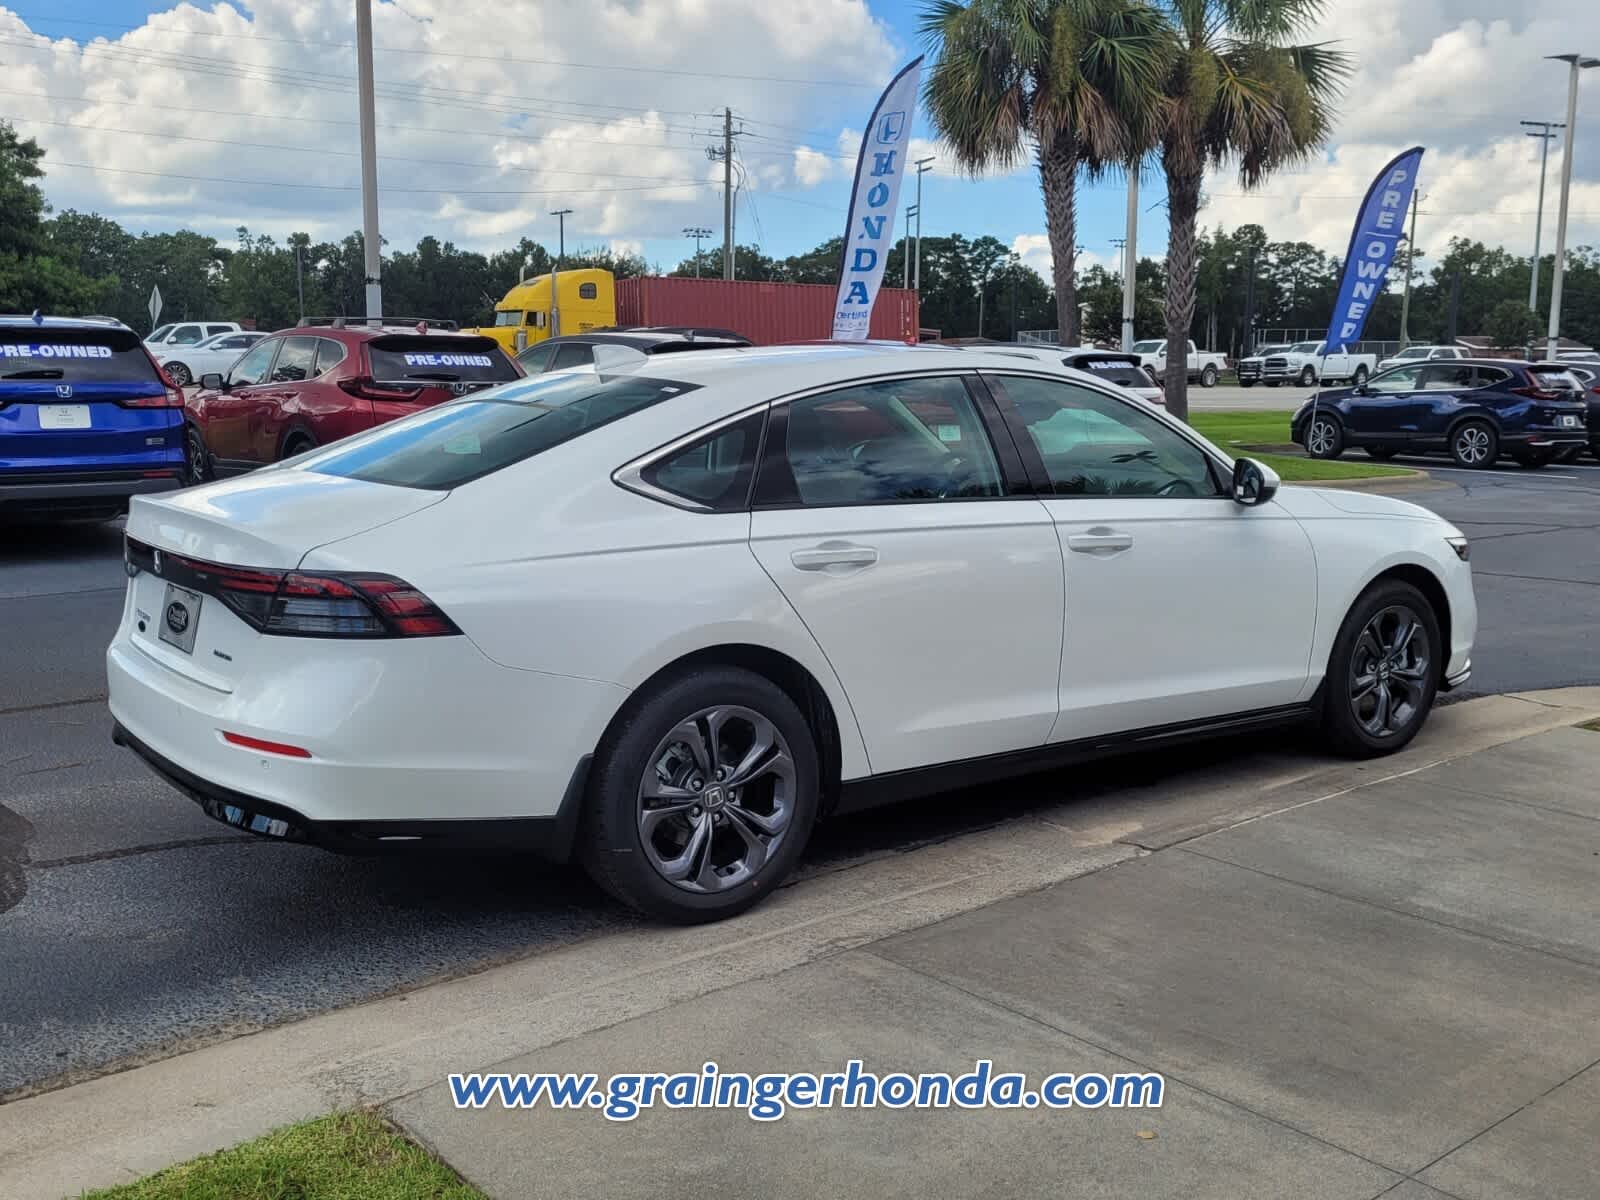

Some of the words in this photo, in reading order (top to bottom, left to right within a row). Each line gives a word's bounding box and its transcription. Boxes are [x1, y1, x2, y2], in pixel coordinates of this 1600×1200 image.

[843, 150, 897, 305] HONDA
[0, 344, 113, 358] RE-OWNED
[403, 354, 493, 367] PRE-OWNED
